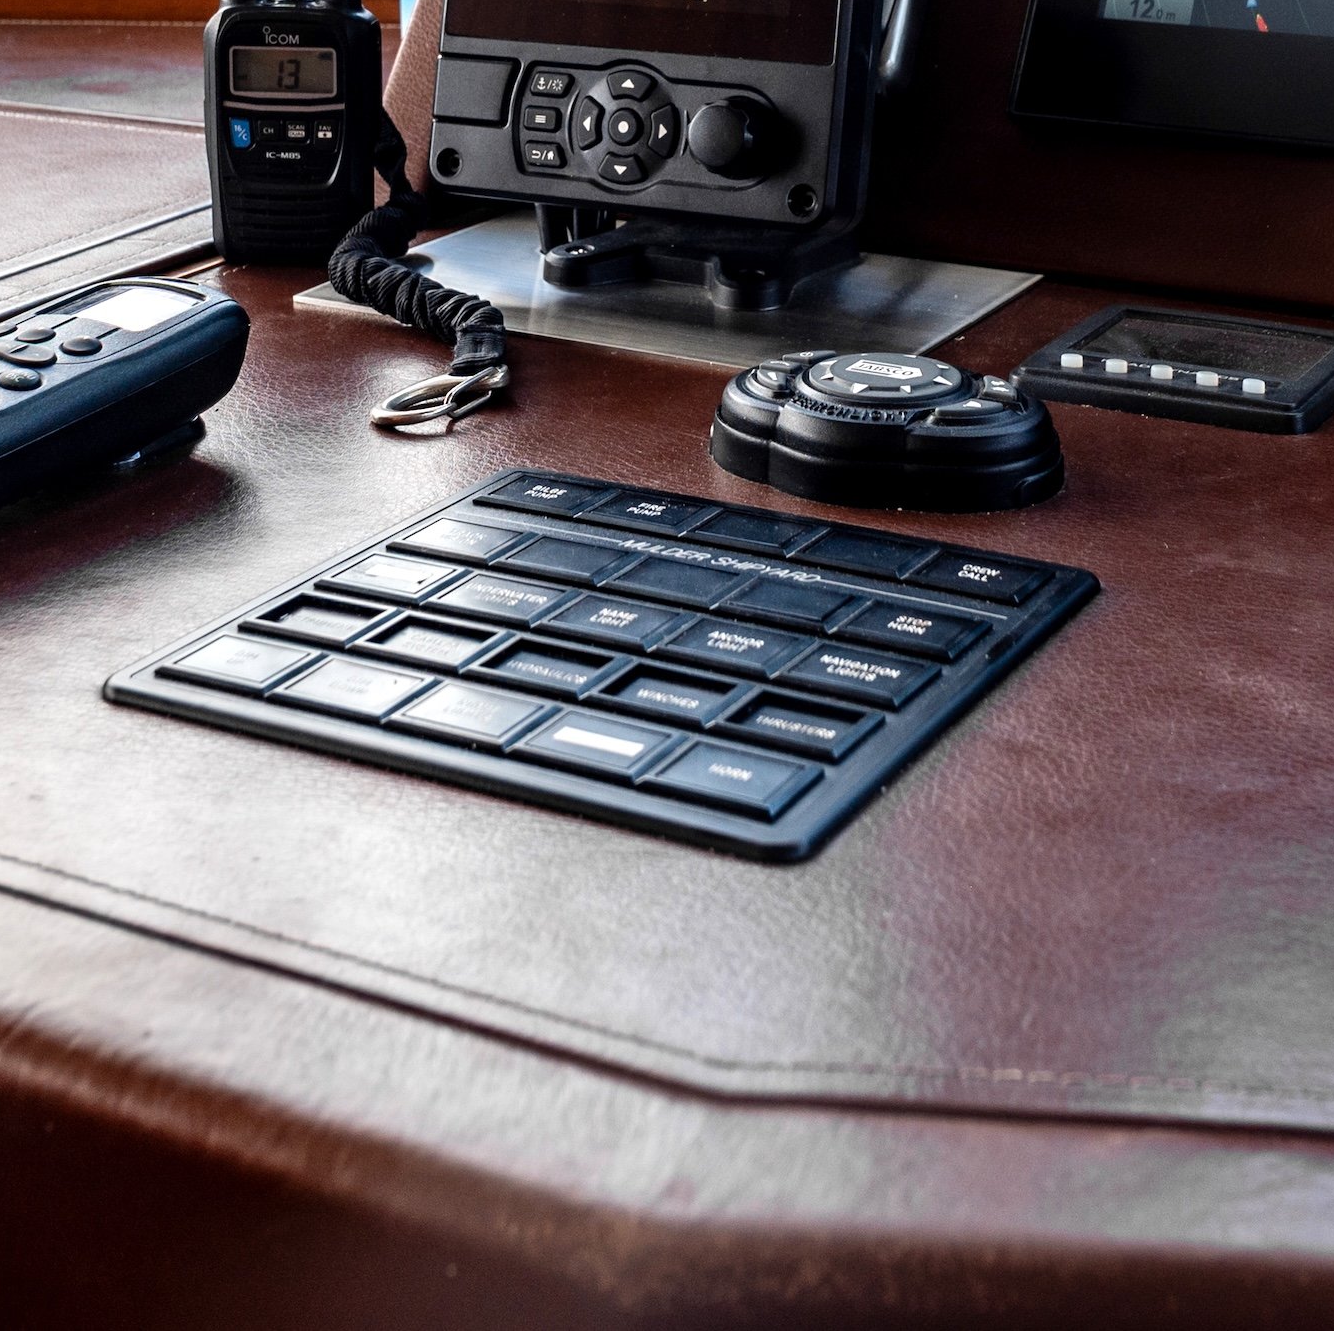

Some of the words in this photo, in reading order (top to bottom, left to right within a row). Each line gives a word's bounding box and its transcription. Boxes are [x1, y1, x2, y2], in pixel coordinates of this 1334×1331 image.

[277, 59, 301, 89] 13
[524, 489, 560, 500] PUMP
[532, 484, 567, 496] BILGE
[626, 506, 662, 517] PUMP
[637, 502, 667, 512] FIRE
[617, 538, 712, 562] MULDER
[710, 555, 823, 584] SHIPYARD
[957, 570, 988, 583] CALL
[961, 563, 1000, 579] CREW
[466, 582, 548, 605] UNDERWATER
[589, 615, 631, 629] LIGHT
[599, 607, 638, 622] NAME
[895, 615, 933, 628] STOP
[887, 621, 927, 636] HORN
[706, 637, 747, 654] LIGHT
[707, 630, 765, 649] ANCHOR
[506, 659, 588, 684] HYDRAULICS
[820, 654, 902, 679] NAVIGATION
[826, 664, 877, 683] LIGHTS
[636, 687, 700, 710] WINCHES
[756, 713, 837, 740] THRUSTERS
[709, 762, 753, 782] HORN
